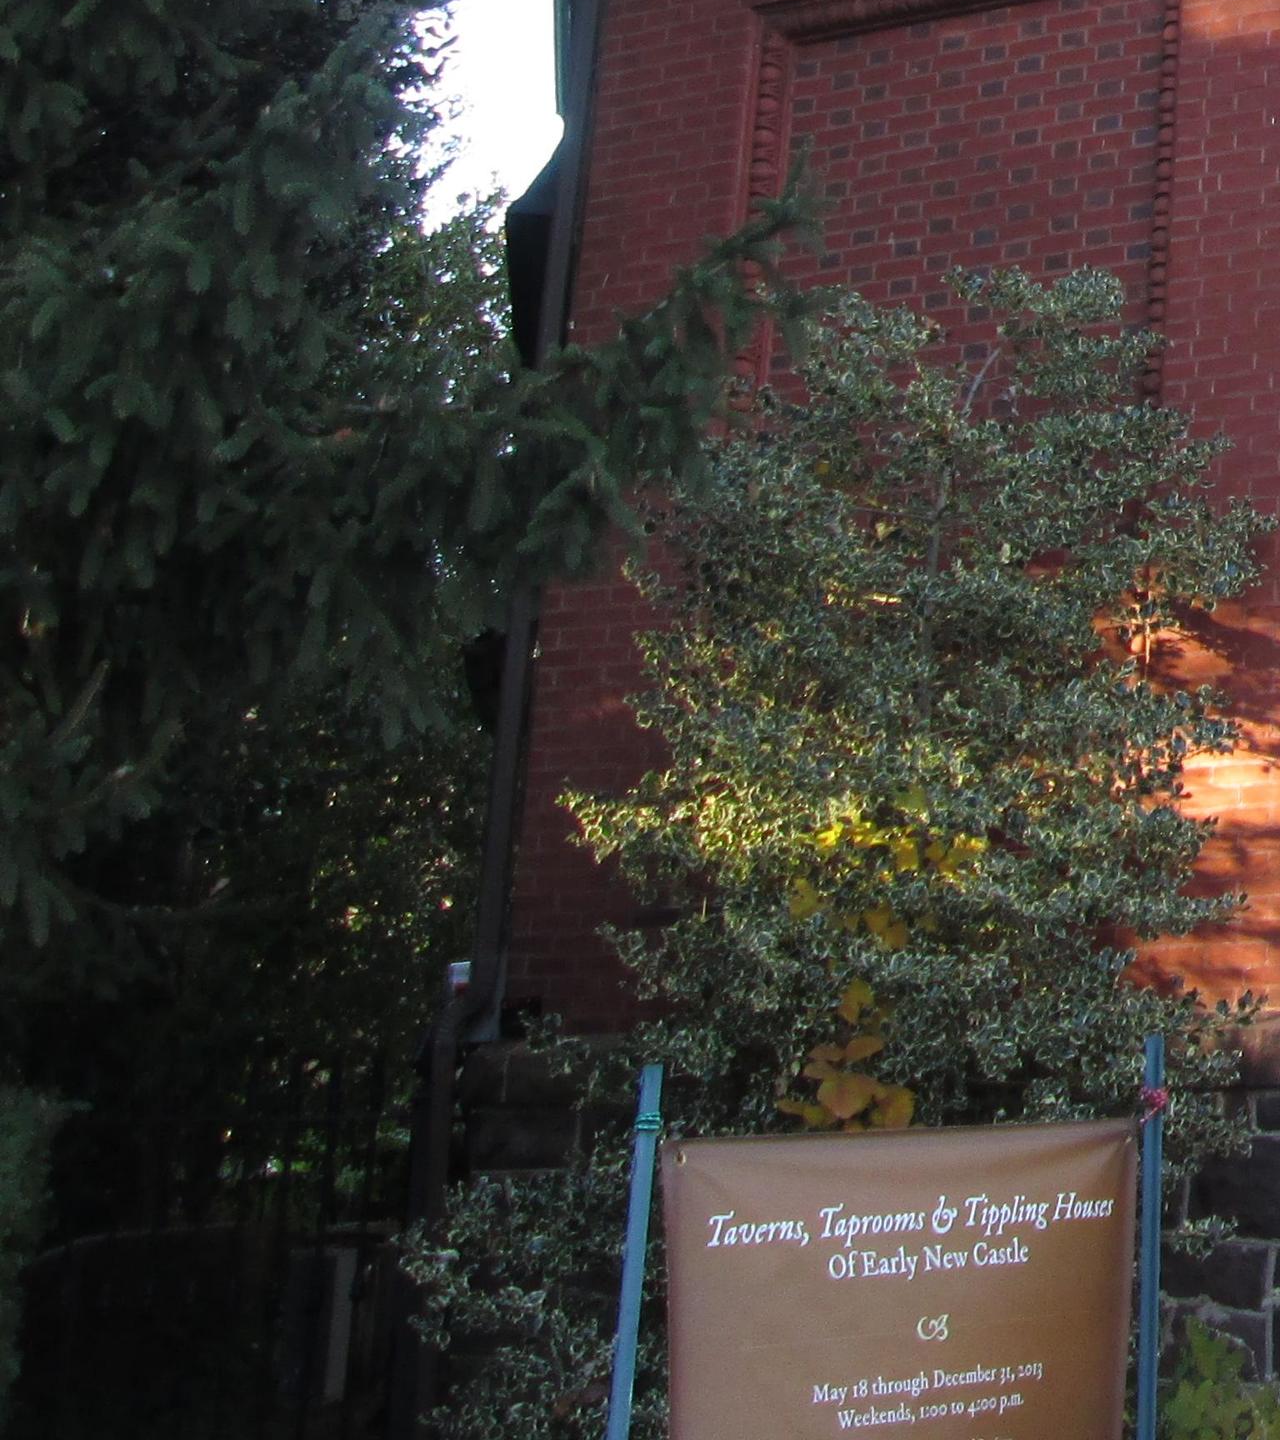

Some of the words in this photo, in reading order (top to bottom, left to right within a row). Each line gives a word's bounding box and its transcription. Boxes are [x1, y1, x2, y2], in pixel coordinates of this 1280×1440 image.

[707, 1210, 812, 1247] Taverns,
[818, 1202, 925, 1248] Taprooms
[931, 1194, 958, 1234] &
[964, 1192, 1050, 1236] Tippling
[1052, 1191, 1115, 1221] Houses
[828, 1250, 859, 1279] Of
[861, 1246, 919, 1281] Early
[923, 1244, 969, 1272] New
[973, 1237, 1030, 1265] Castle
[812, 1384, 848, 1405] May
[852, 1379, 868, 1399] 18
[871, 1370, 930, 1397] through
[933, 1364, 996, 1388] December
[1000, 1367, 1015, 1385] 31,
[1018, 1362, 1044, 1380] 2013
[837, 1403, 916, 1429] Weekends,
[919, 1402, 948, 1419] 1:00
[951, 1401, 965, 1414] to
[967, 1396, 998, 1418] 4:00
[999, 1391, 1025, 1415] p.m.
